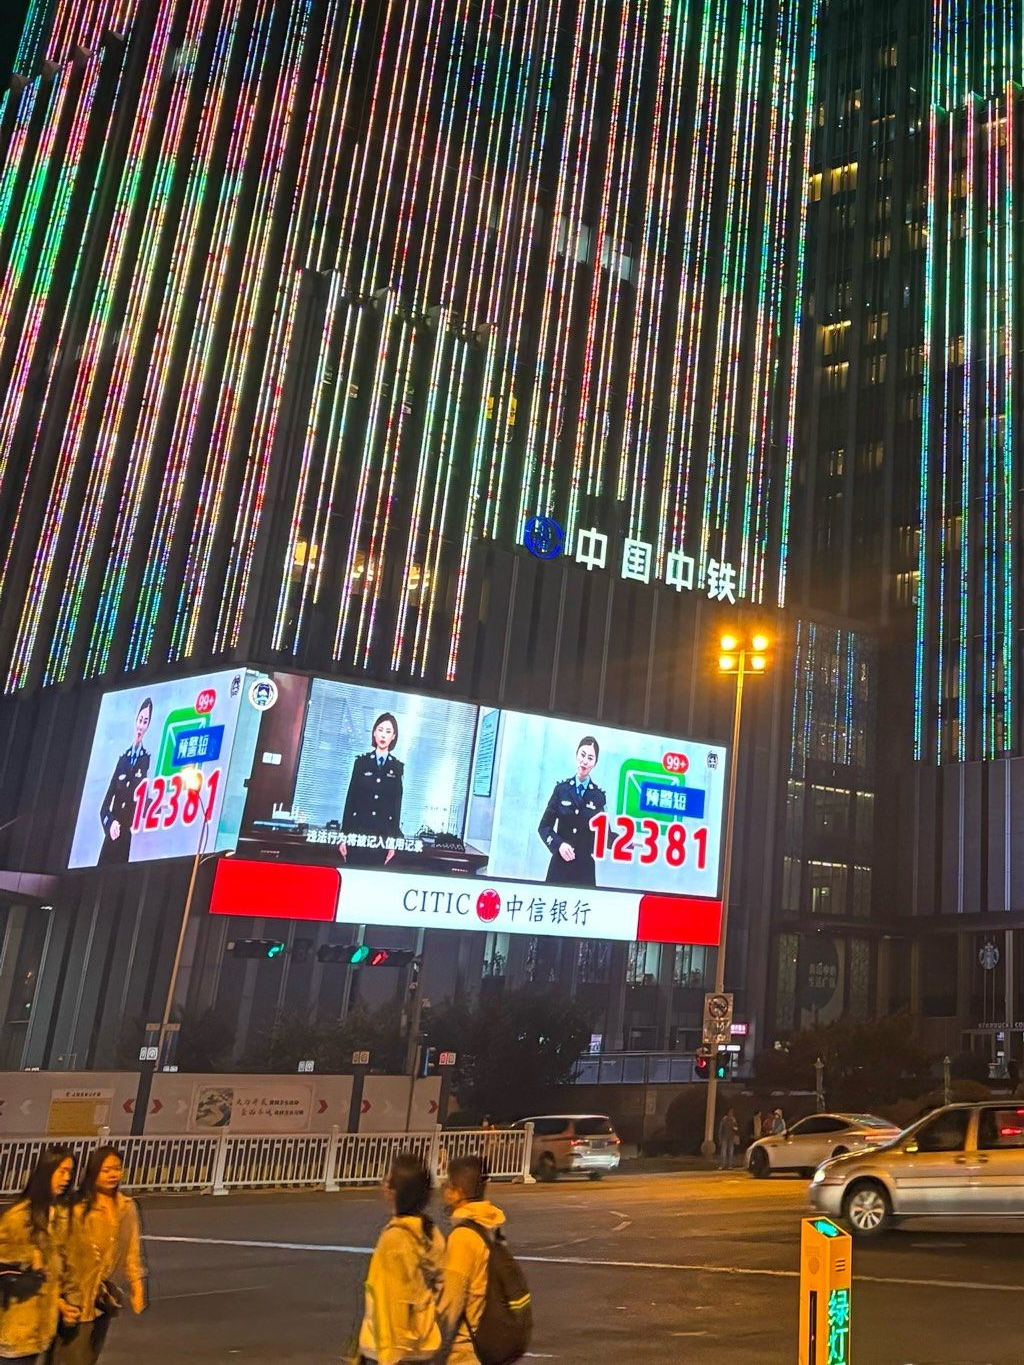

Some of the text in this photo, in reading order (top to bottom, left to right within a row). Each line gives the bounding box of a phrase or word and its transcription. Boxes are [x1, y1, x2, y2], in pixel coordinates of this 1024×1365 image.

[575, 527, 736, 604] 中国中铁
[197, 693, 214, 711] 99+
[666, 755, 687, 771] 99+
[645, 788, 687, 812] 预警短
[589, 813, 709, 870] 12381
[403, 888, 471, 916] CITIC
[506, 894, 592, 926] 中信银行
